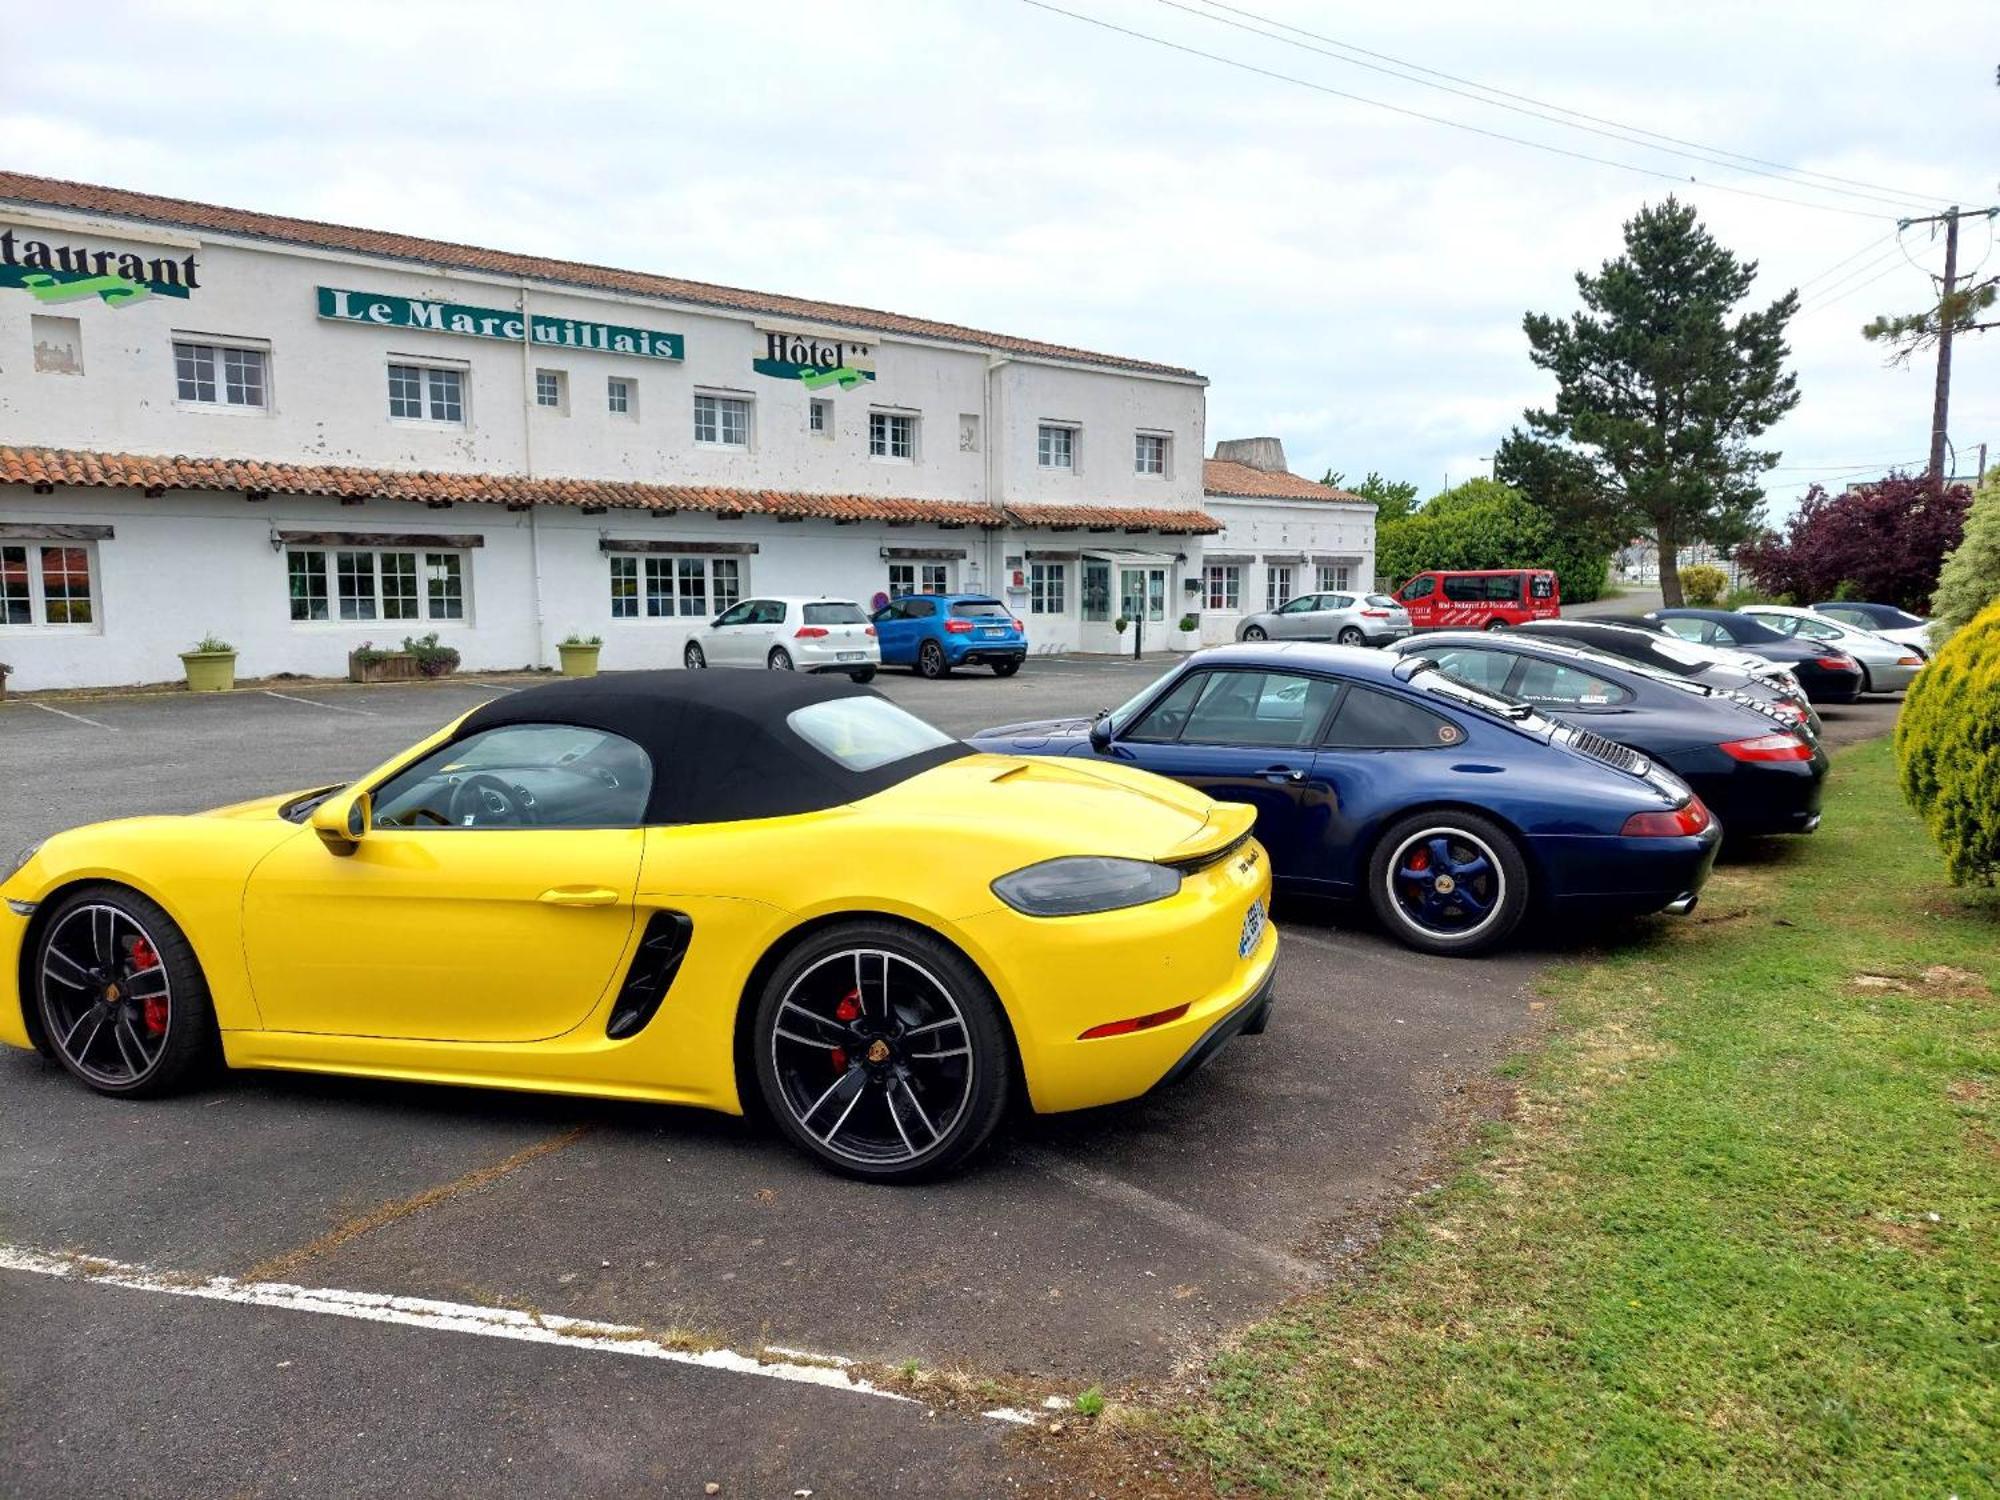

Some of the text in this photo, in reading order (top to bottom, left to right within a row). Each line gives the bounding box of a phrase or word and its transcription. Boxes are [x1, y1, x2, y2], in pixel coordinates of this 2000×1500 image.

[0, 228, 201, 288] taurant
[331, 290, 673, 357] Le Mareuillais
[766, 333, 844, 369] Hôtel
